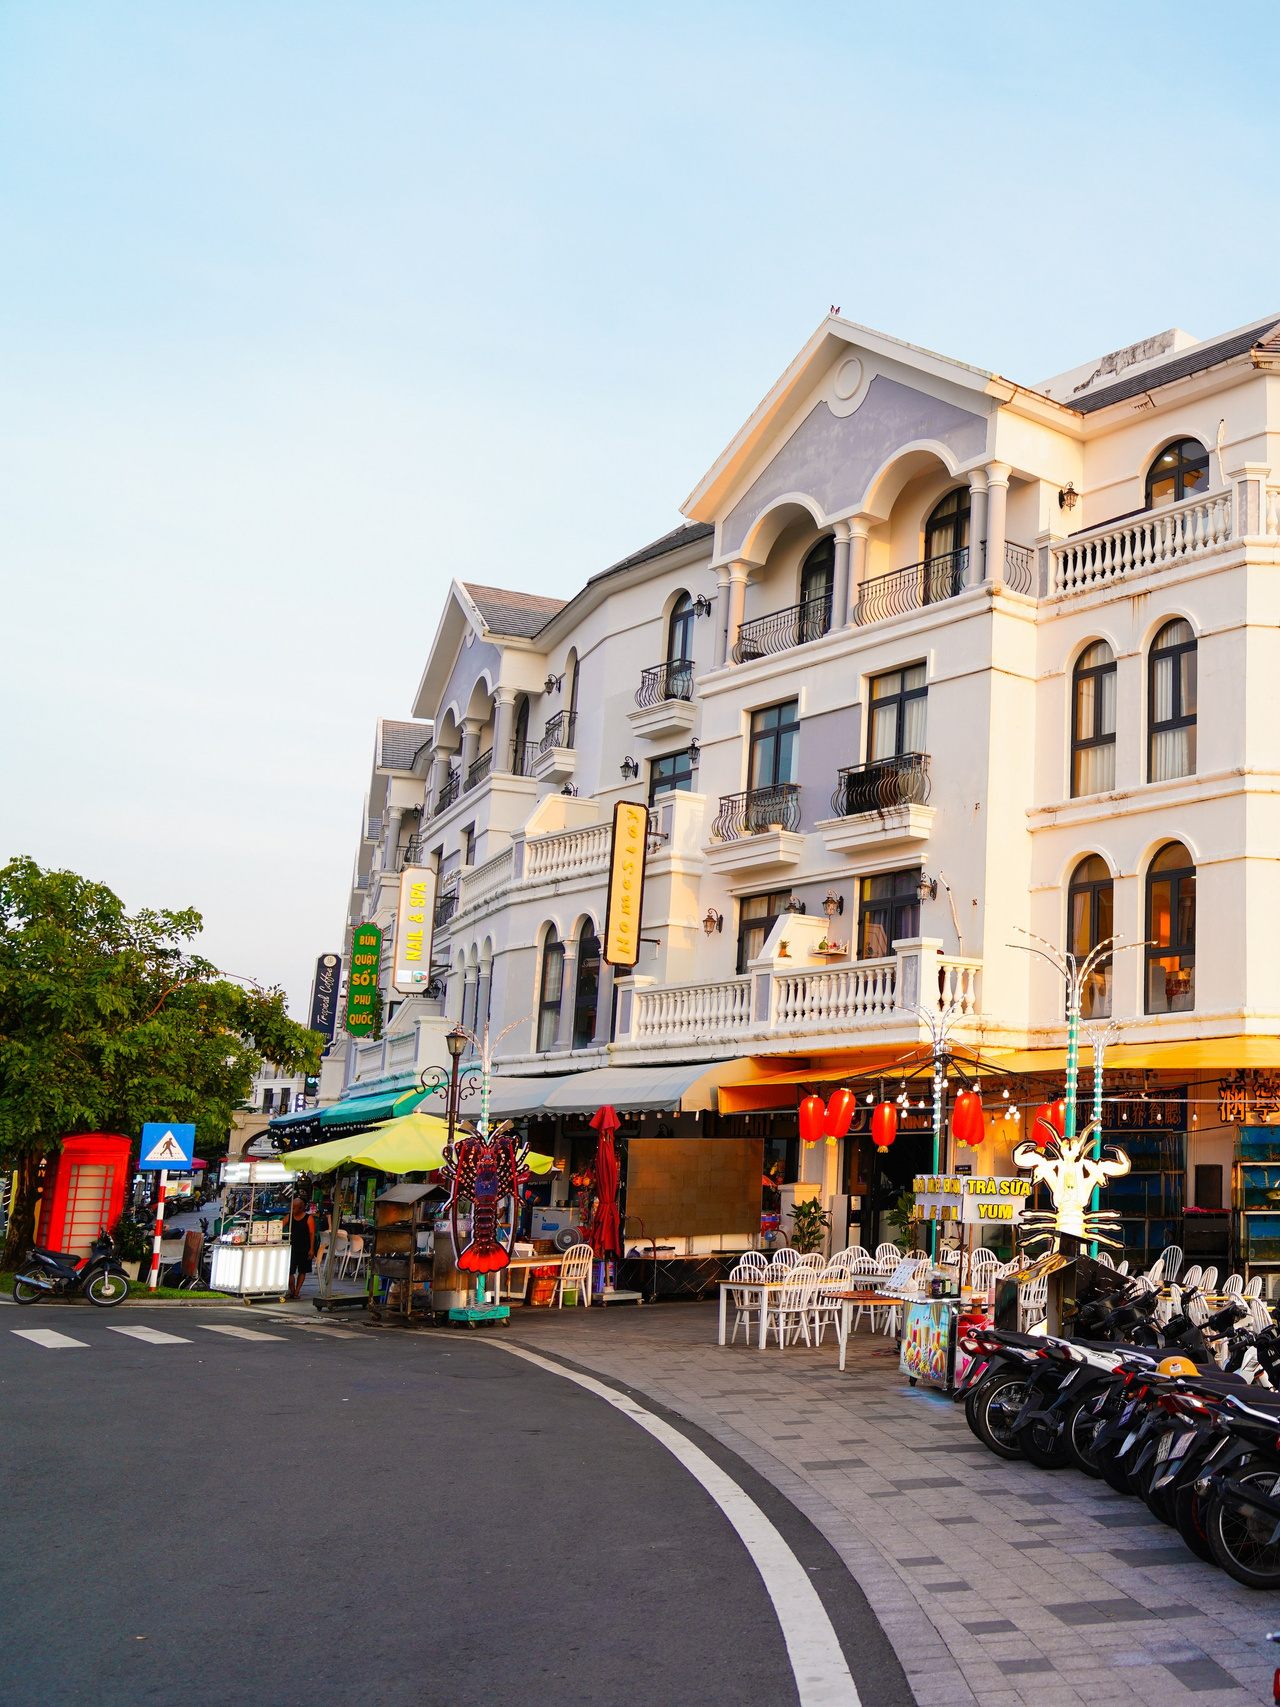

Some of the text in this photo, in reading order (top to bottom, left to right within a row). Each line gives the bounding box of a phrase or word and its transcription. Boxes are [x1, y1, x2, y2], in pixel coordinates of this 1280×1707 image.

[406, 882, 426, 961] NAIL & SPA
[360, 933, 377, 946] BÚN
[318, 967, 335, 993] Coffee
[354, 993, 371, 1005] PHÚ
[349, 1012, 373, 1025] QUỐC
[900, 1115, 932, 1130] NINH
[967, 1177, 997, 1195] TRÀ
[999, 1178, 1031, 1196] SỮA
[978, 1204, 1014, 1220] YUM
